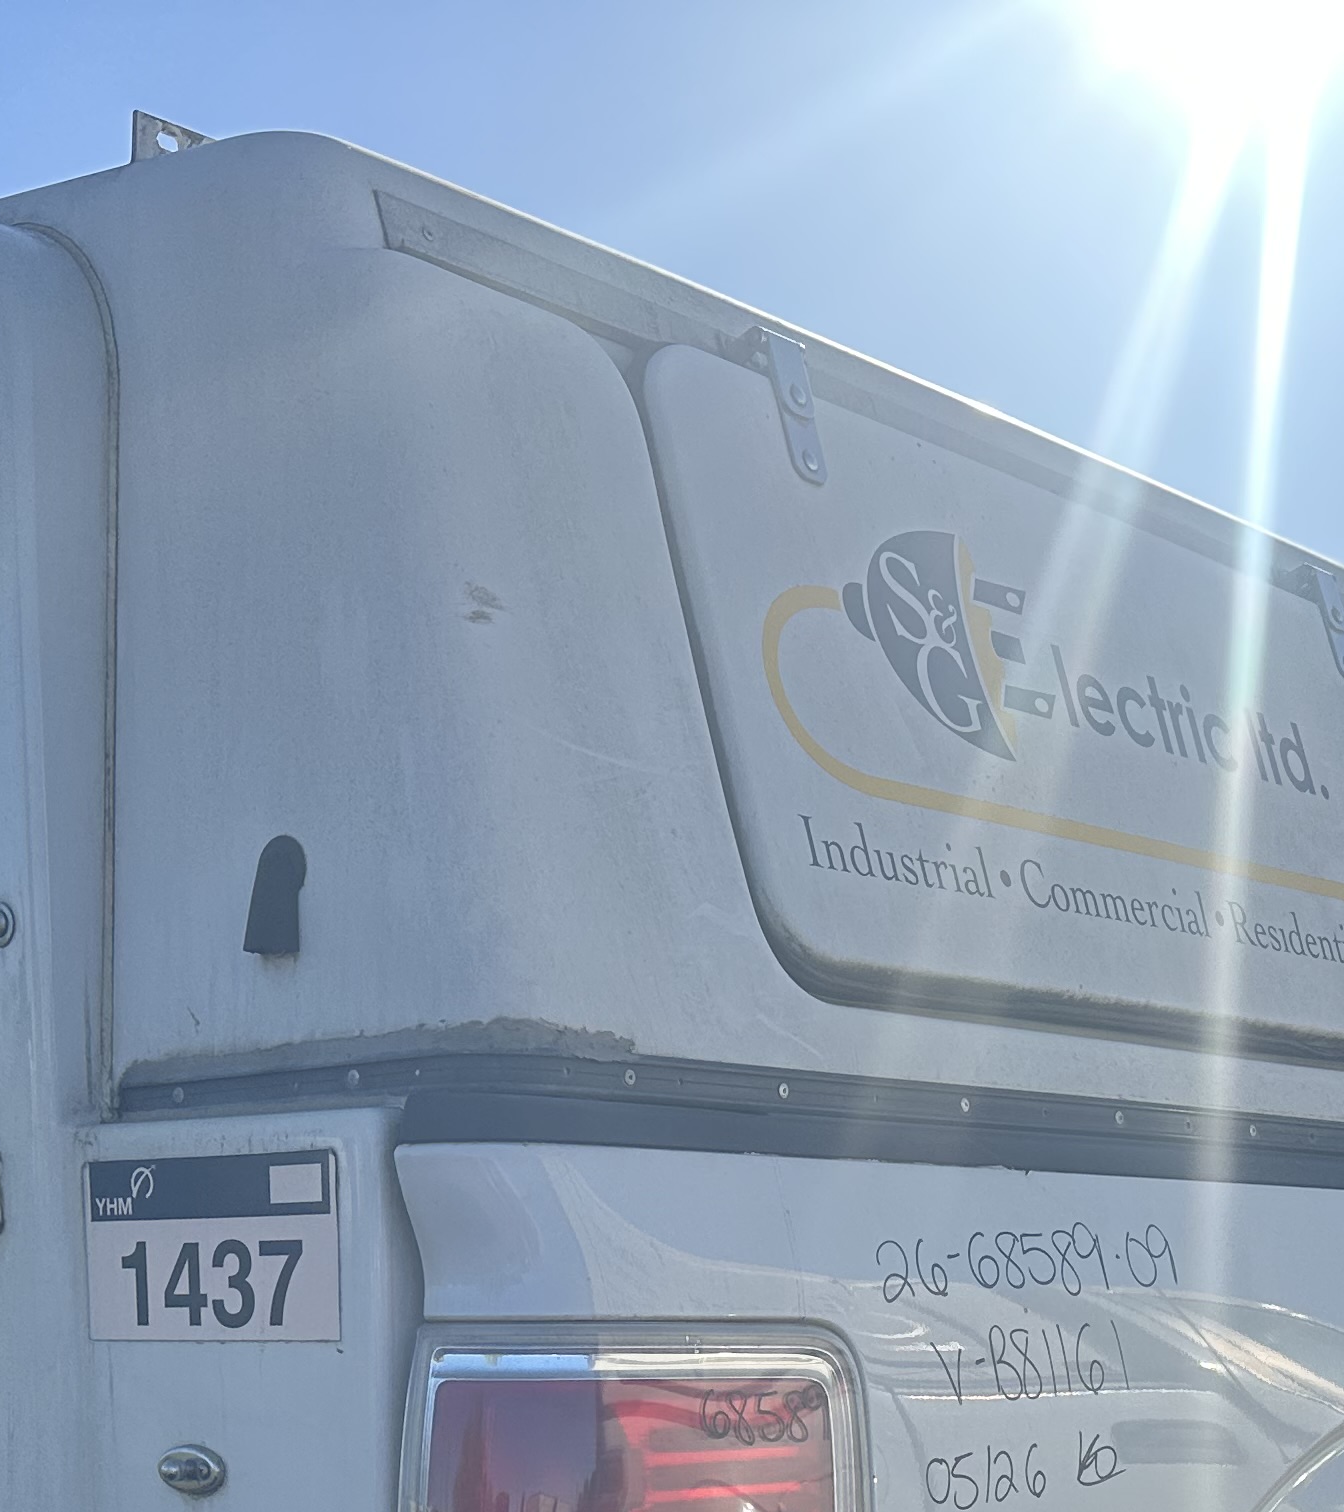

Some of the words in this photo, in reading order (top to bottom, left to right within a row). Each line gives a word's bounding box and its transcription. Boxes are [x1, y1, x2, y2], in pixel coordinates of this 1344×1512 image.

[798, 812, 996, 900] Industrial
[1019, 858, 1212, 940] Commercial
[94, 1196, 134, 1217] YHM
[121, 1238, 304, 1329] 1437
